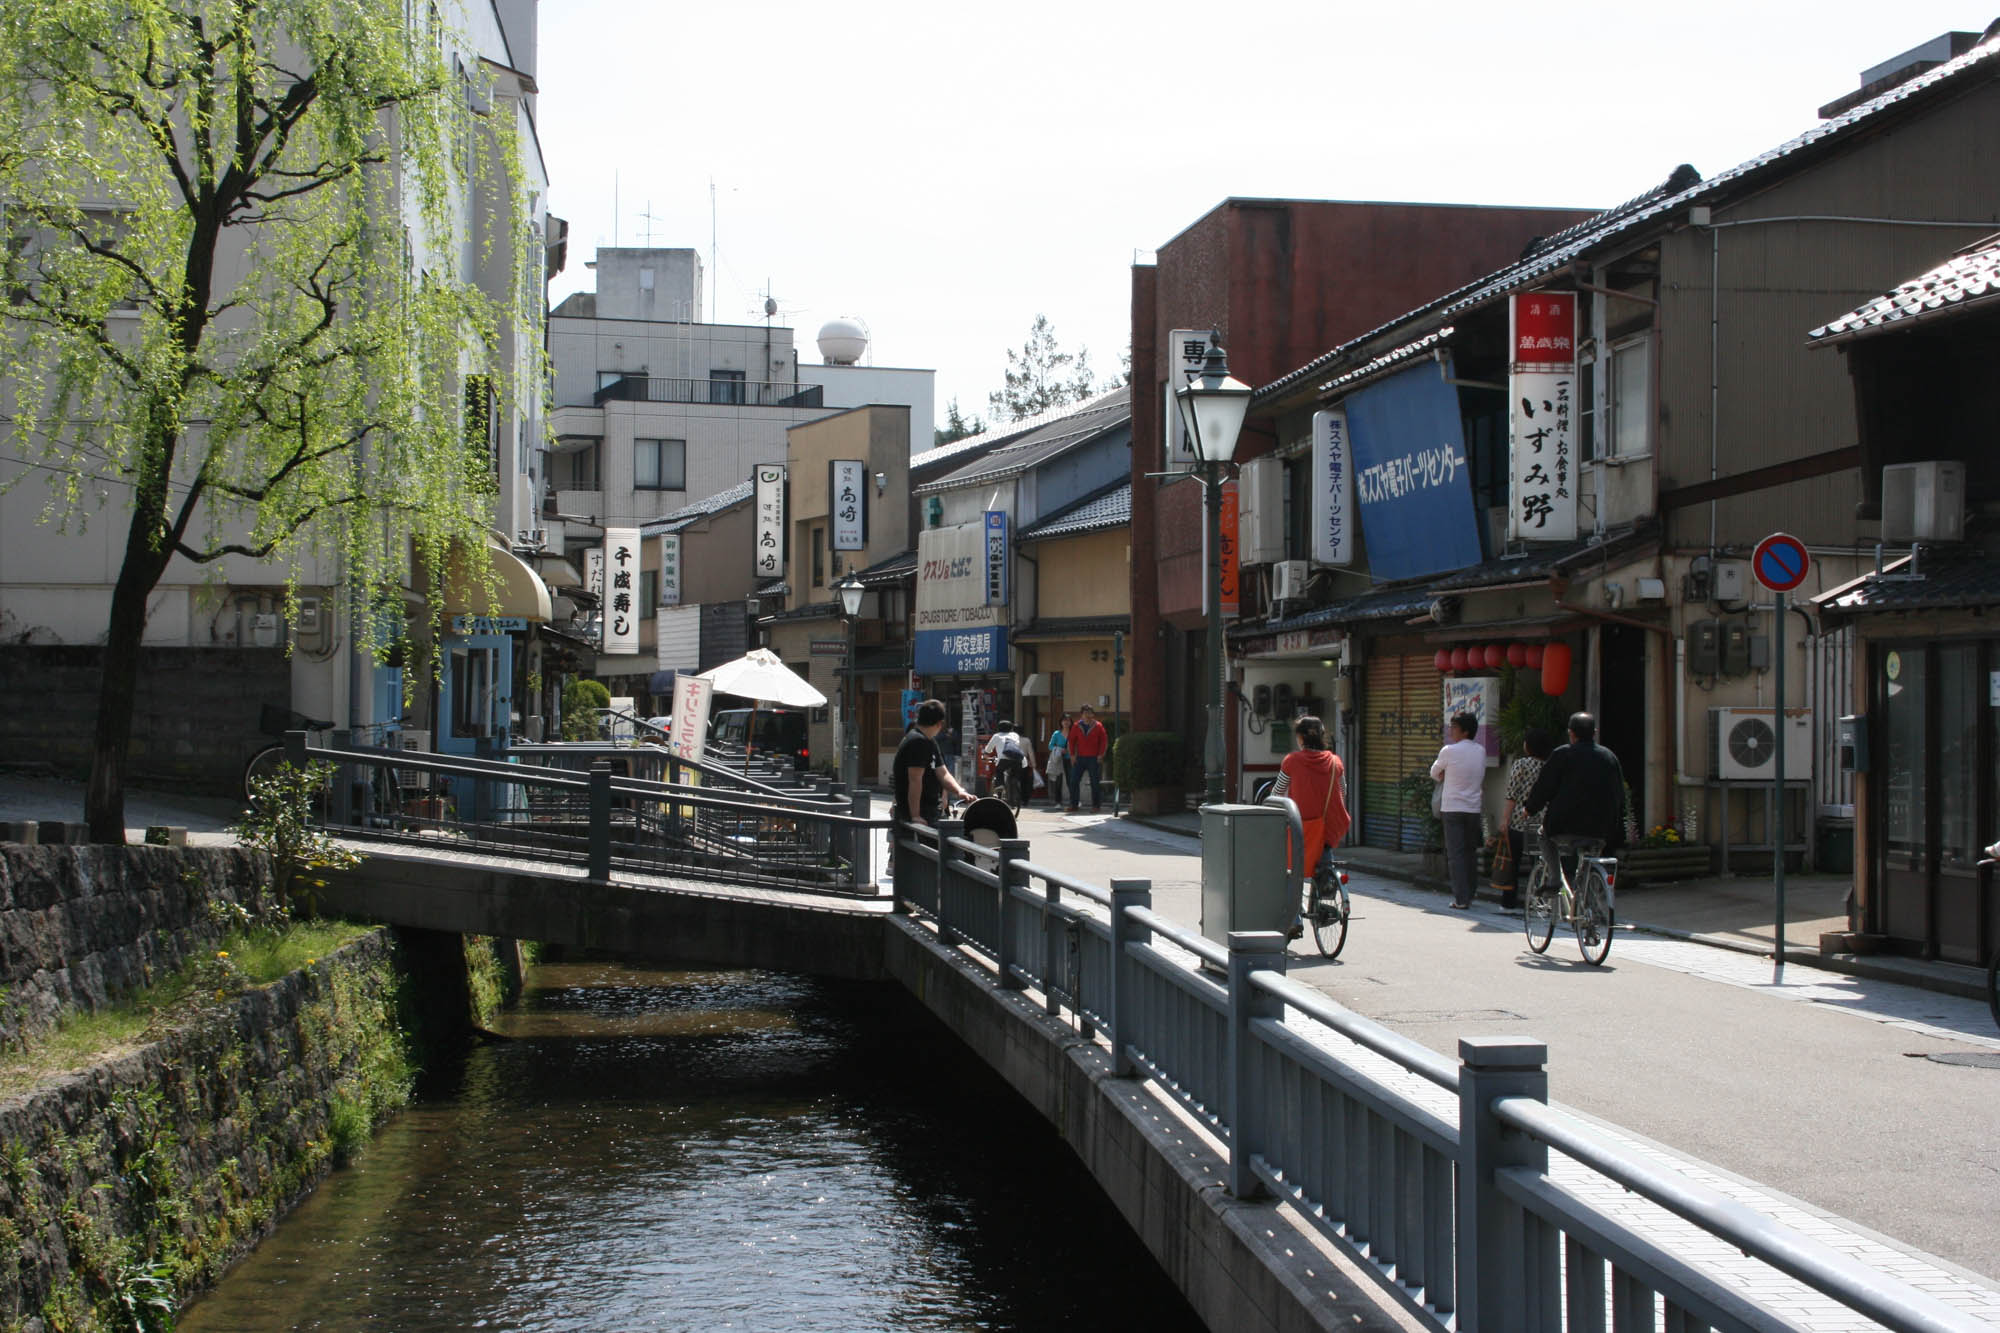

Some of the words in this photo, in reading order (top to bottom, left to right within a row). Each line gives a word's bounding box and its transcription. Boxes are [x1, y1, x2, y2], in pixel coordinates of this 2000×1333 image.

[1521, 397, 1554, 528] いずみ野
[614, 546, 632, 636] 千成寿し
[942, 632, 991, 655] ホリ保安堂薬局
